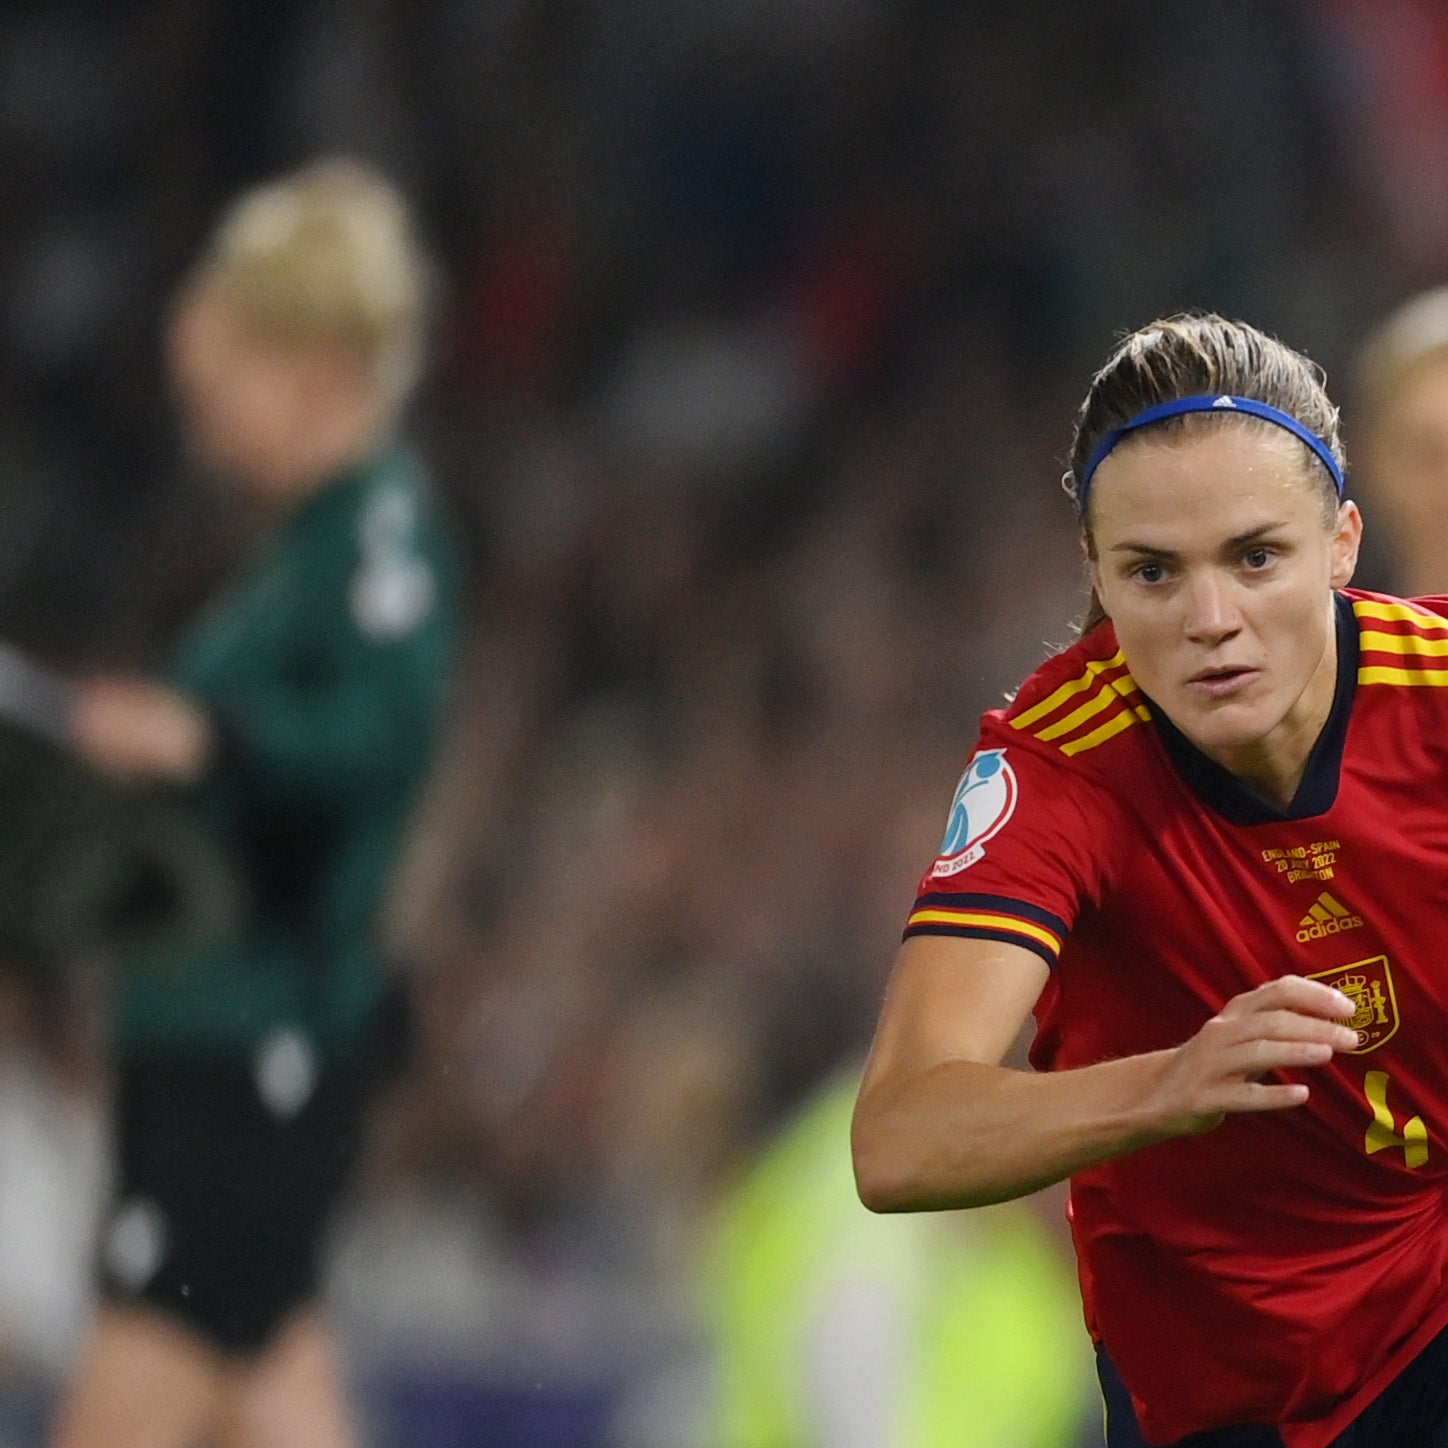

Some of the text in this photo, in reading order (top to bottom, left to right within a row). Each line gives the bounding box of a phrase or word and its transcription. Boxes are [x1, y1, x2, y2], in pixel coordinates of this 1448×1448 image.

[952, 851, 976, 870] 2022
[1275, 859, 1288, 873] 20
[1312, 852, 1336, 869] 2022
[1296, 916, 1364, 943] adidas
[1364, 1070, 1429, 1169] 4
